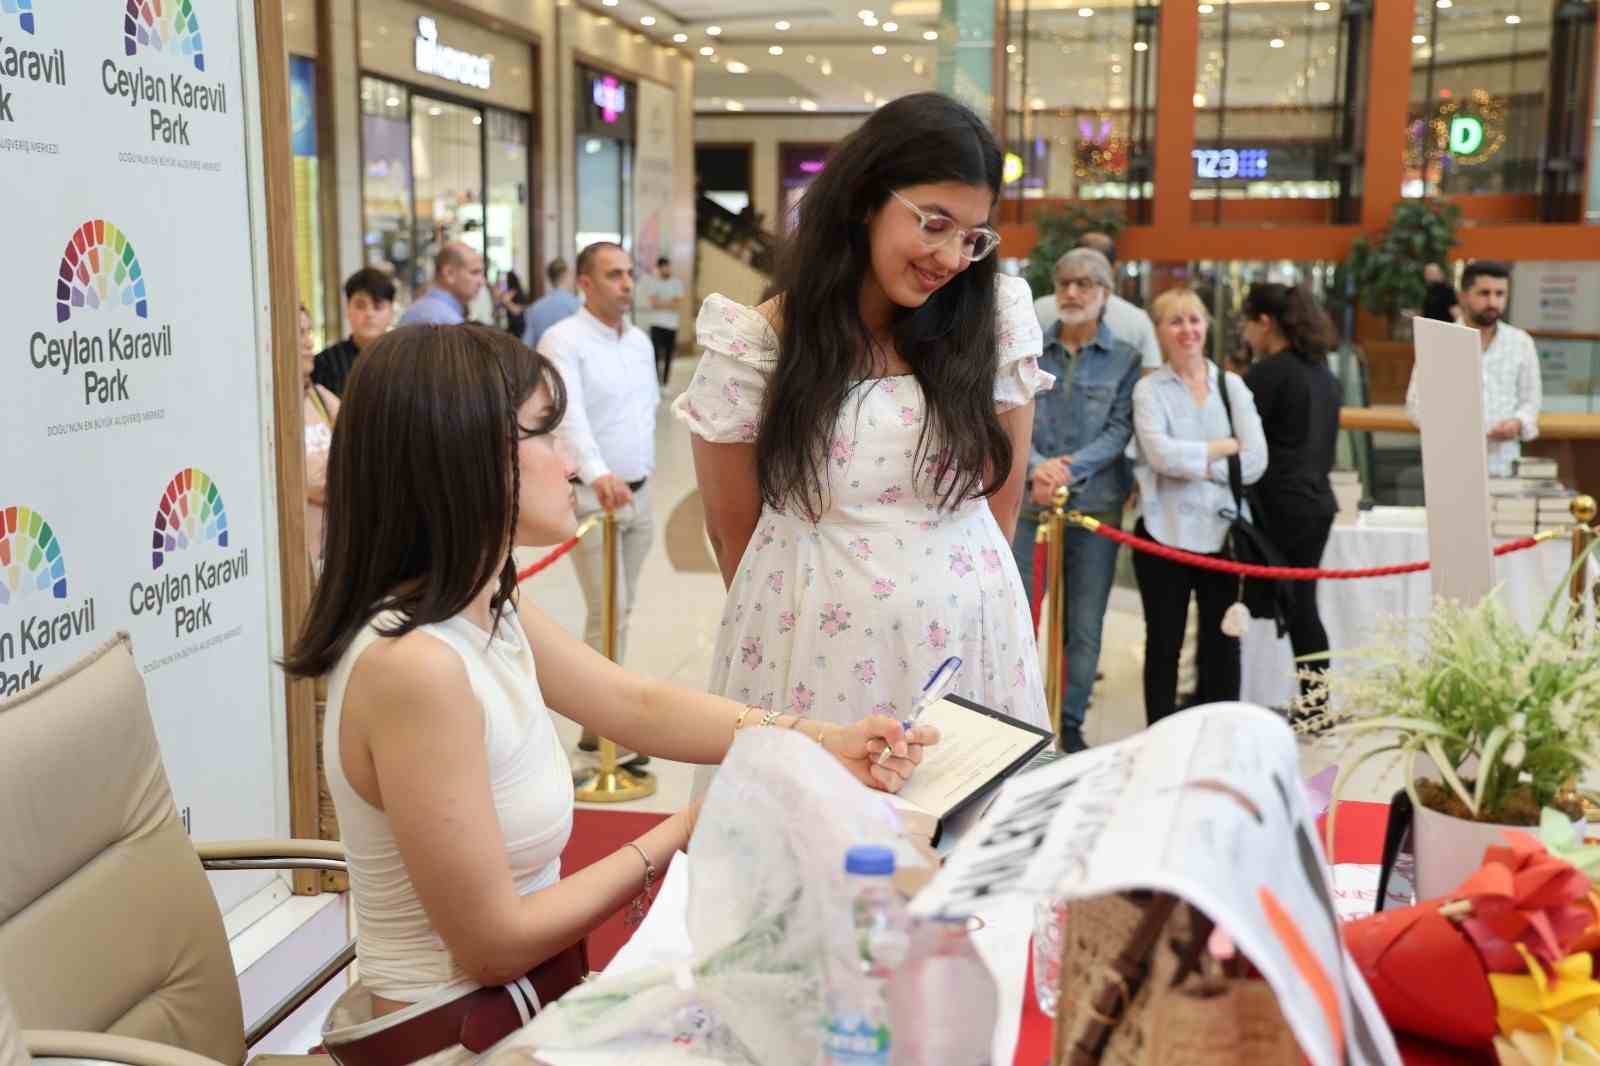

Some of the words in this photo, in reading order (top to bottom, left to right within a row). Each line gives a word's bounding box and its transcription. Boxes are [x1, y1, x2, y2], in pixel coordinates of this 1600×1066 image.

[102, 59, 166, 107] Ceylan
[171, 73, 226, 113] Karavil
[150, 109, 190, 146] Park
[1450, 117, 1481, 153] D
[30, 331, 103, 375] Ceylan
[109, 324, 172, 362] Karavil
[85, 368, 129, 405] Park
[130, 573, 191, 616] Ceylan
[195, 548, 248, 593] Karavil
[21, 597, 95, 655] Karavil
[175, 598, 212, 637] Park
